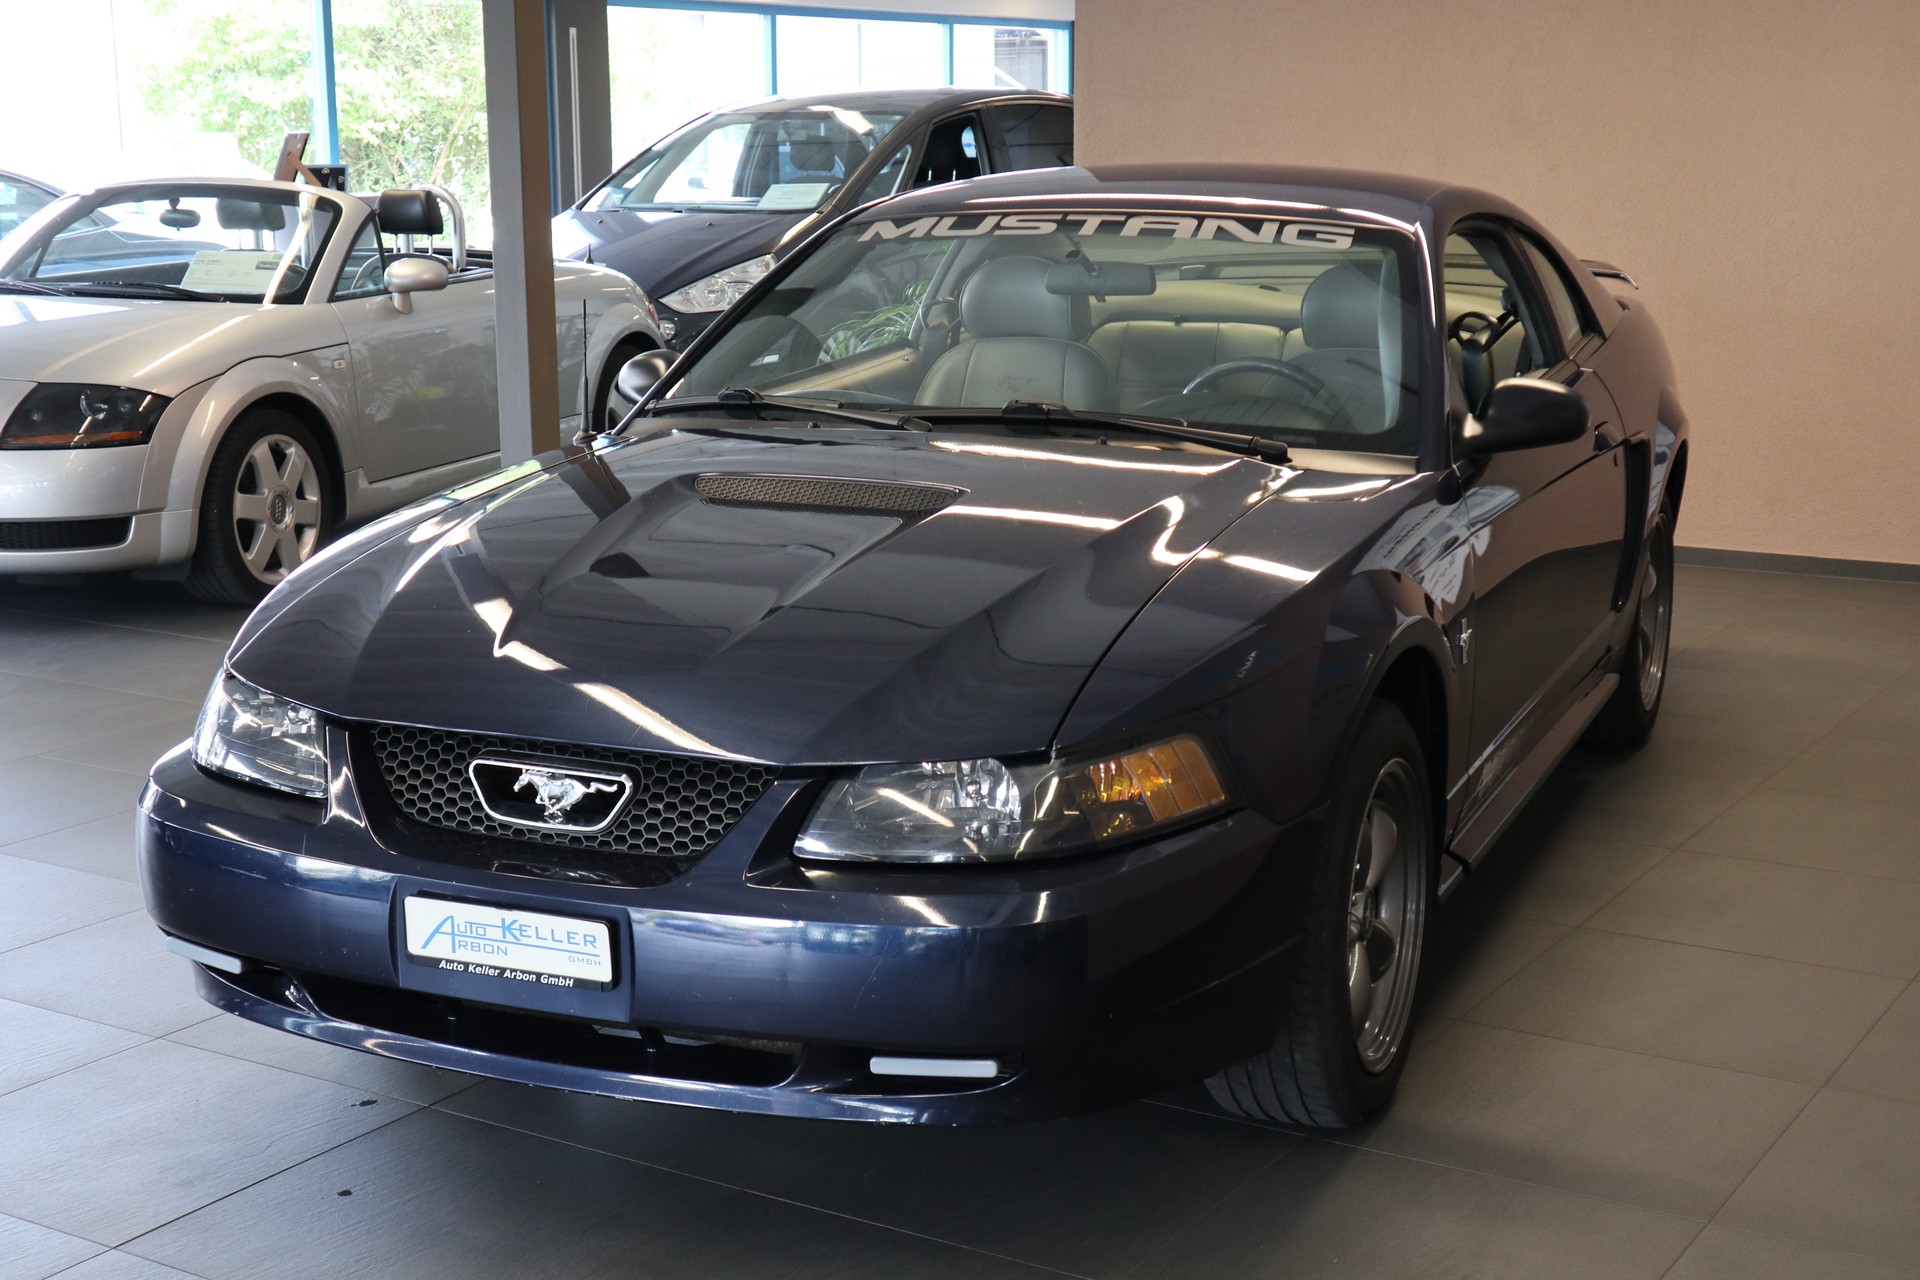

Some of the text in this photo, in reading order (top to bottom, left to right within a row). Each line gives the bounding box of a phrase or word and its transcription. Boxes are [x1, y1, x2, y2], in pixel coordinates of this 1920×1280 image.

[857, 214, 1355, 250] MUSTANG
[501, 917, 598, 949] KELLER
[439, 959, 574, 988] Auto Keller Arbon GmbH
